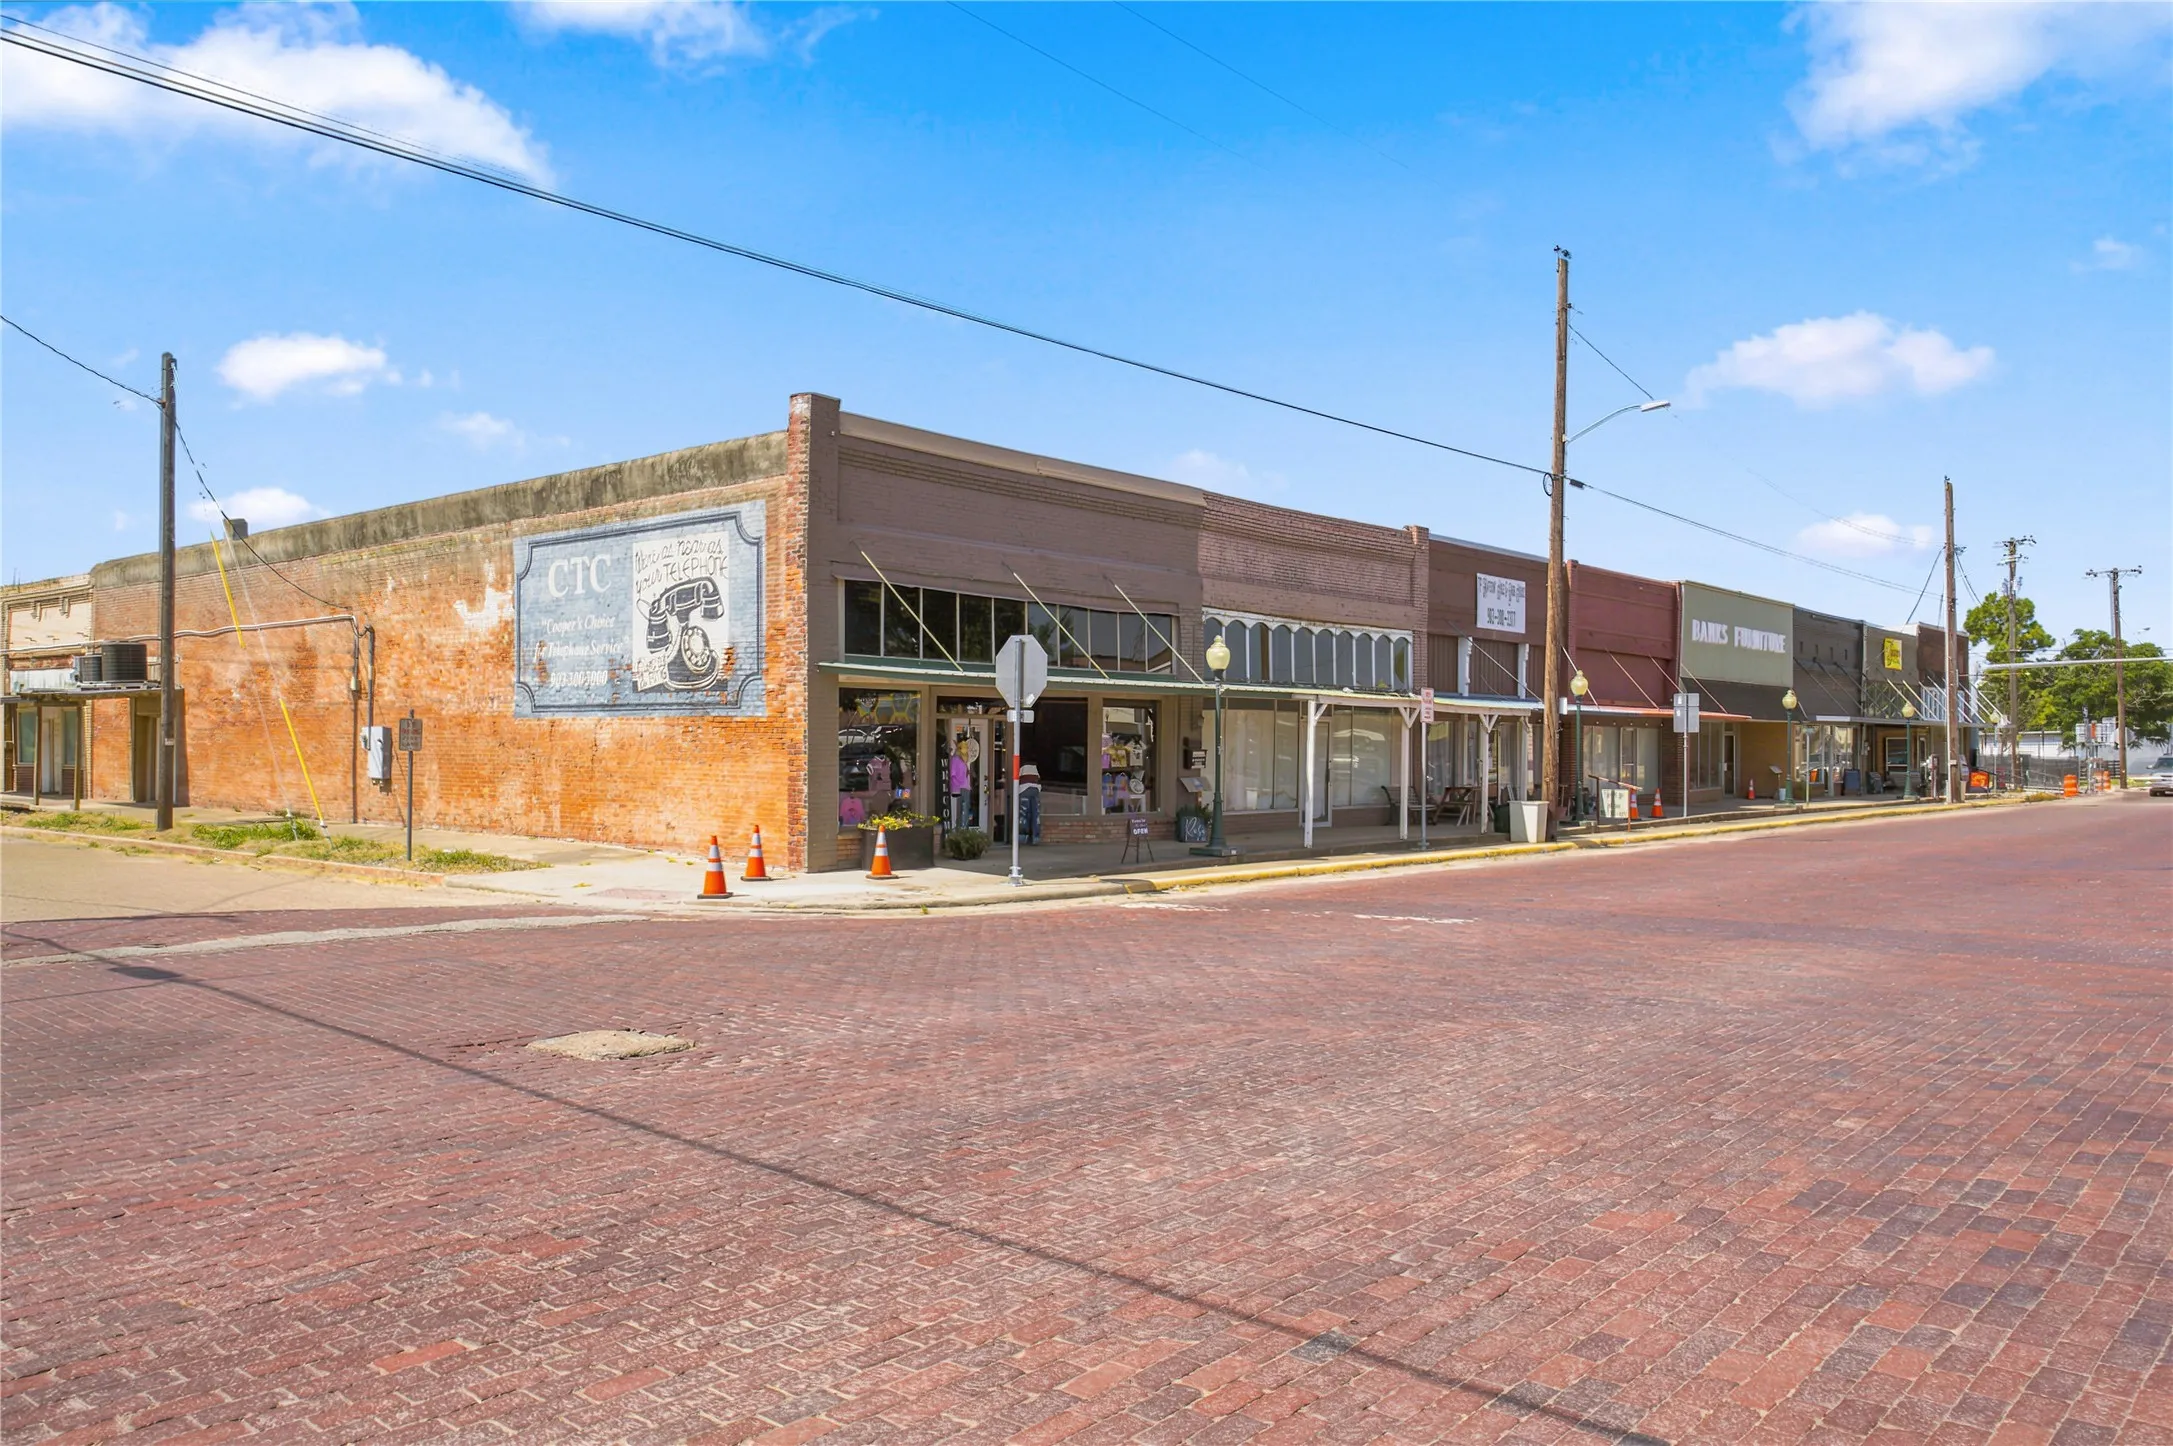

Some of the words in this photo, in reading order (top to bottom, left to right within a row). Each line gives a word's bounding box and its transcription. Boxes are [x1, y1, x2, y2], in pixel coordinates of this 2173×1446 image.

[548, 554, 611, 598] CTC
[663, 555, 728, 582] TELEPHONE
[1692, 618, 1729, 645] BANKS
[1733, 625, 1786, 653] FURNITURE
[1132, 827, 1149, 835] OPEN
